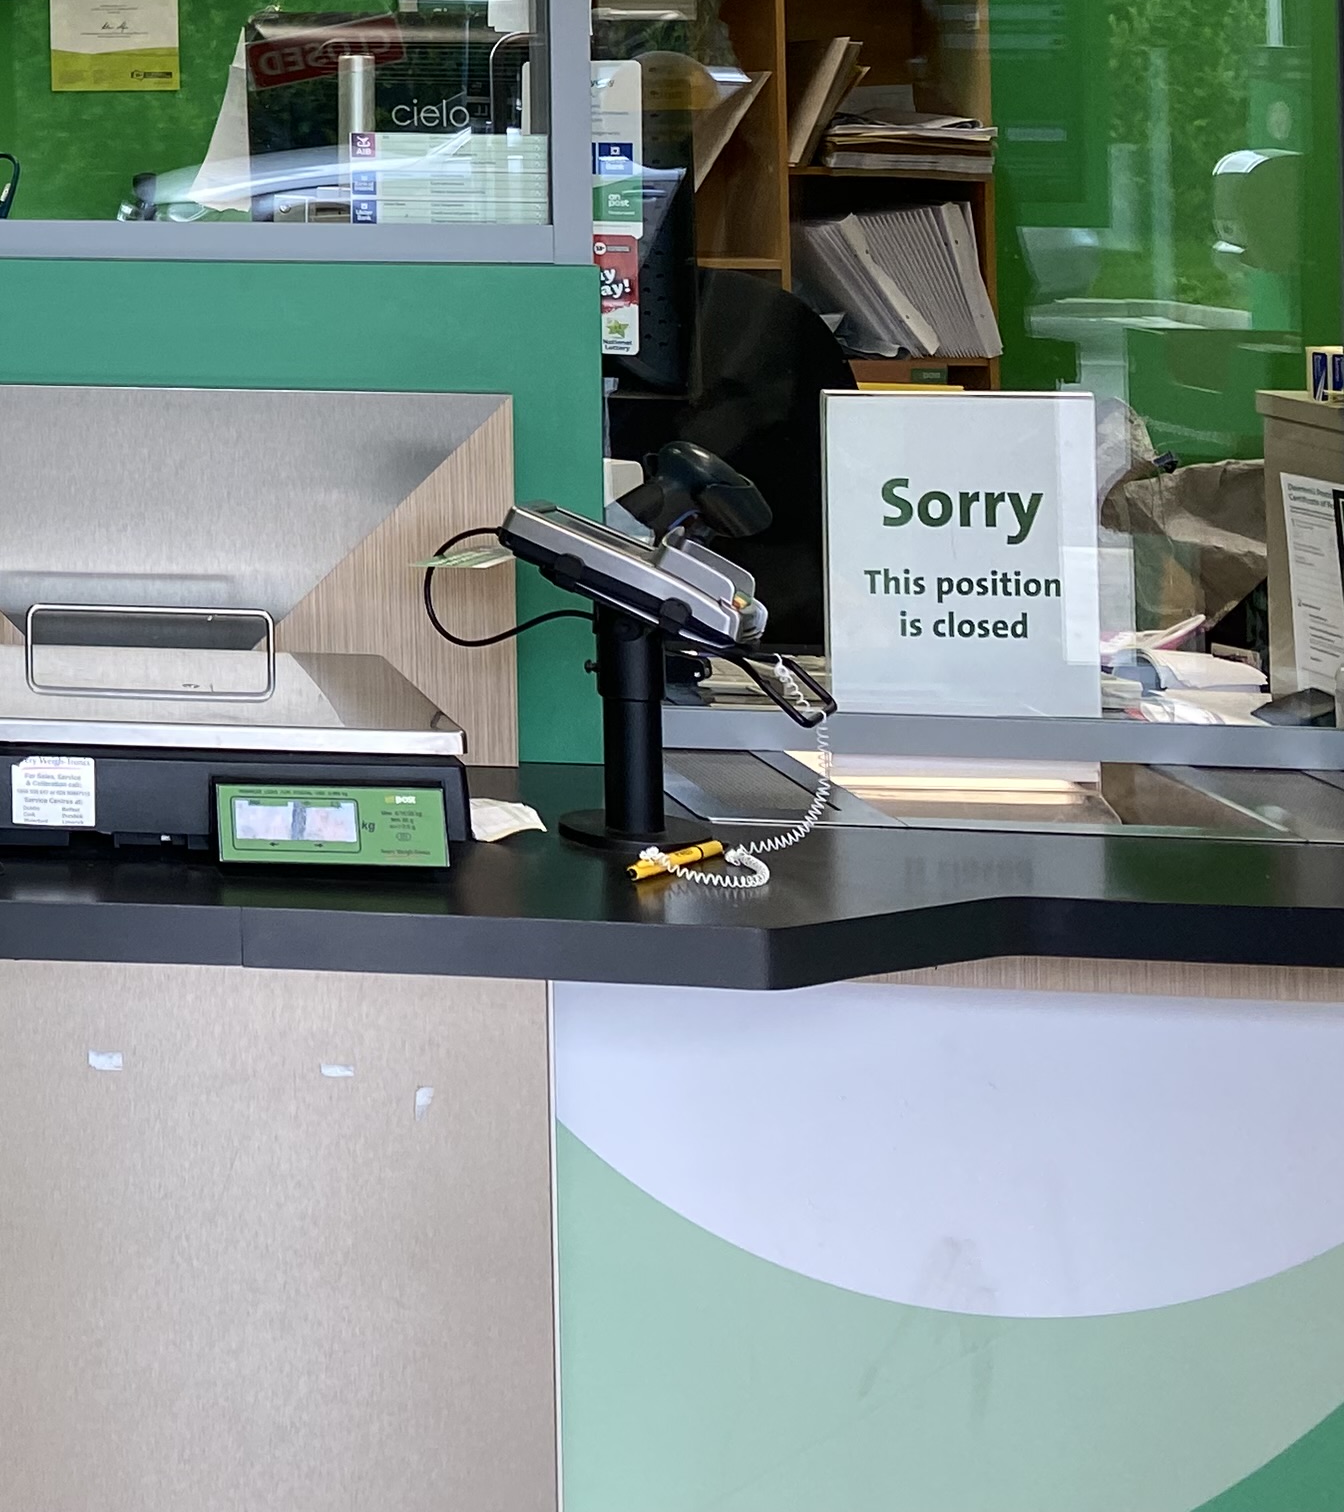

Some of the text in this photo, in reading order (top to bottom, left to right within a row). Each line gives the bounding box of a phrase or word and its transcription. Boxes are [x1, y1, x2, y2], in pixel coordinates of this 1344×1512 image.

[392, 99, 469, 127] cielo
[881, 478, 1043, 545] Sorry
[864, 568, 1062, 603] This position
[900, 610, 1028, 639] is closed
[362, 821, 375, 832] kg
